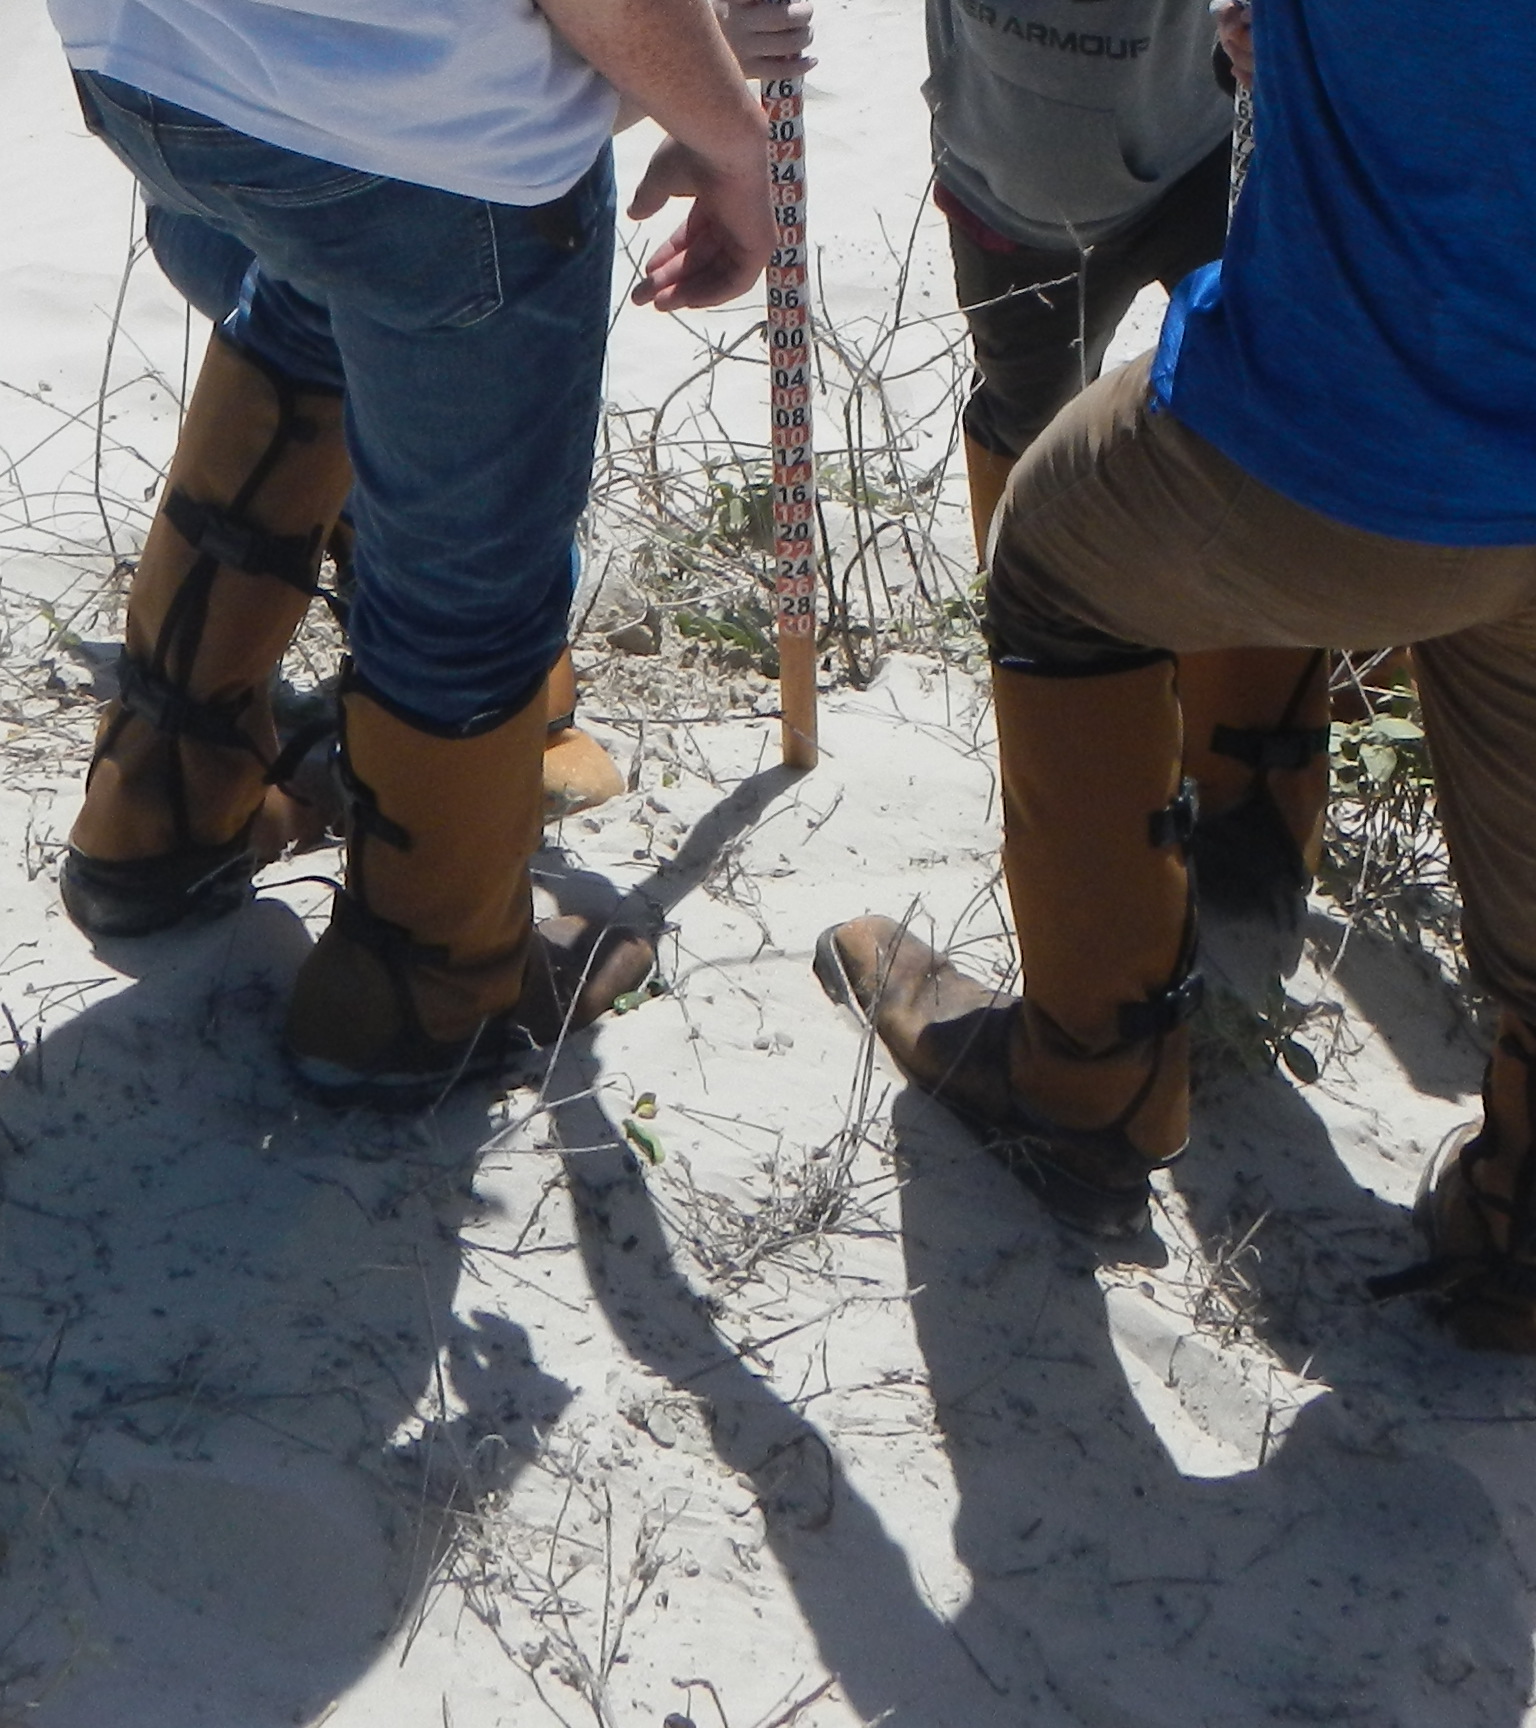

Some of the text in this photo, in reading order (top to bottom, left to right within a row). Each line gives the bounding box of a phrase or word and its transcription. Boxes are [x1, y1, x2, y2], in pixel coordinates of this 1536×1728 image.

[1003, 17, 1152, 60] ARMOUR
[764, 99, 794, 119] 78
[767, 142, 795, 162] 82
[778, 227, 797, 246] 0
[769, 268, 798, 287] 94
[769, 288, 799, 308] 96
[770, 308, 799, 328] 98
[774, 328, 804, 348] 00
[774, 349, 804, 368] 02
[775, 368, 804, 388] 04
[776, 388, 804, 408] 06
[776, 408, 805, 427] 08
[776, 427, 804, 447] 10
[777, 447, 805, 466] 12
[778, 467, 805, 485] 14
[778, 485, 806, 504] 16
[779, 504, 807, 523] 18
[780, 523, 808, 542] 20
[780, 542, 808, 559] 22
[781, 560, 809, 578] 24
[782, 578, 810, 596] 26
[782, 596, 811, 615] 28
